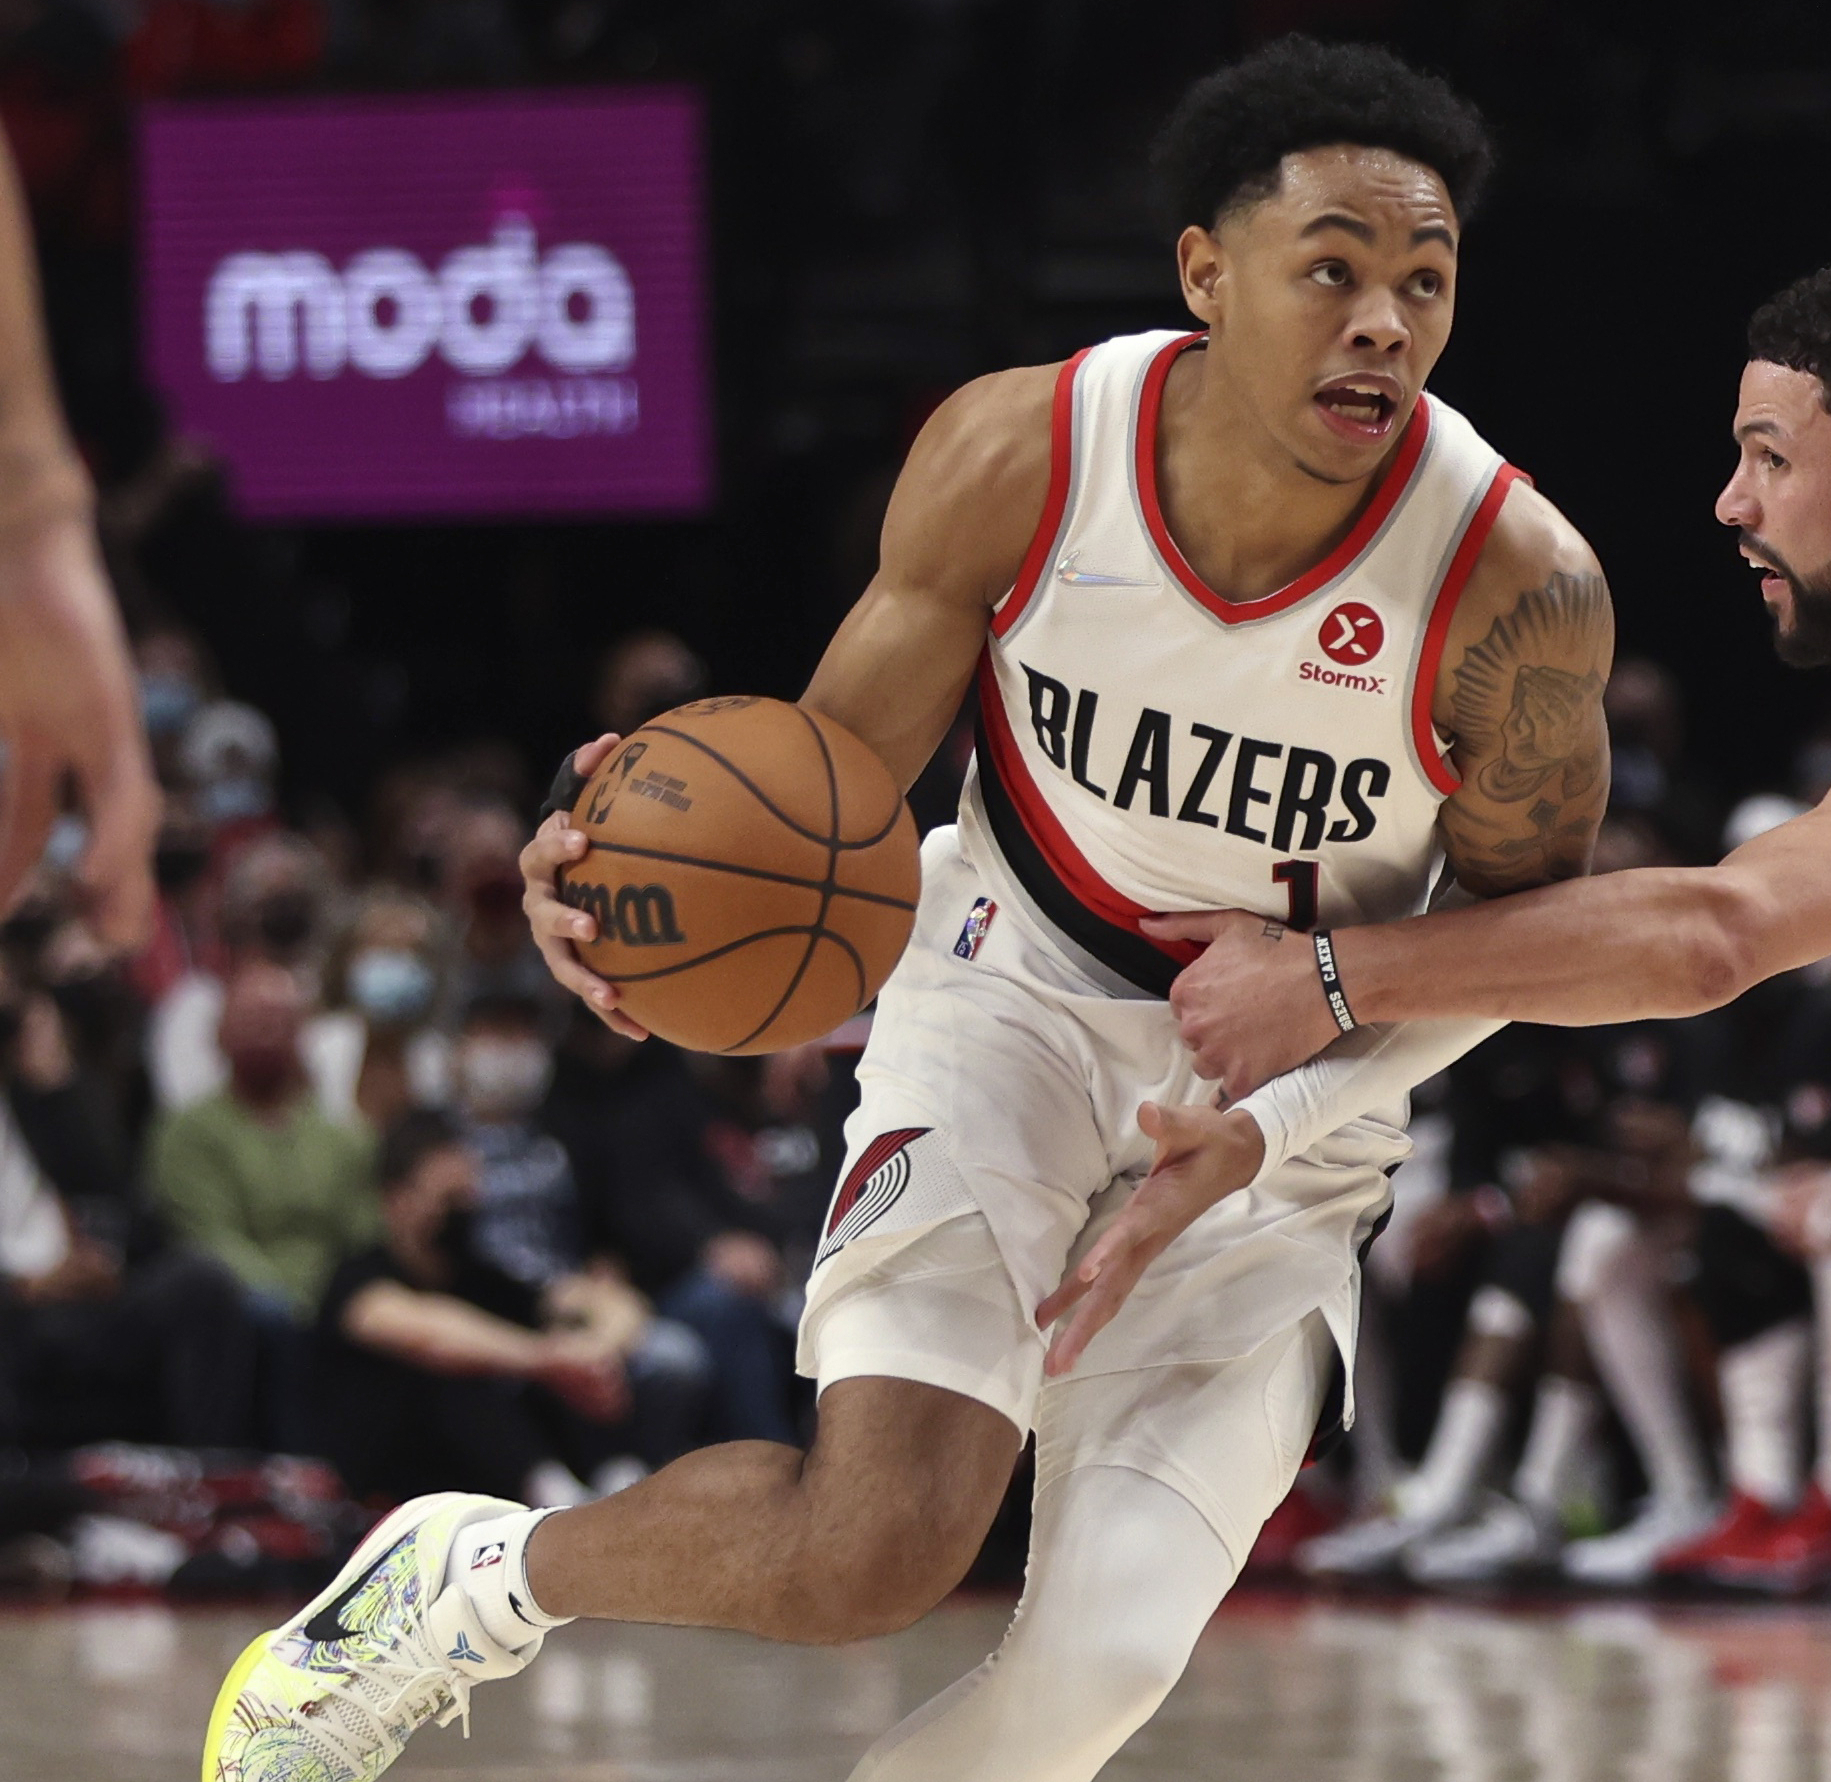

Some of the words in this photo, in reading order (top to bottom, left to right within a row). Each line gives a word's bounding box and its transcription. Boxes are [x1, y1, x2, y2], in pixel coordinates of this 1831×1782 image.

[204, 210, 637, 383] moda
[1299, 661, 1388, 695] StormX
[1018, 660, 1392, 853] BLAZERS
[1272, 858, 1320, 933] 1
